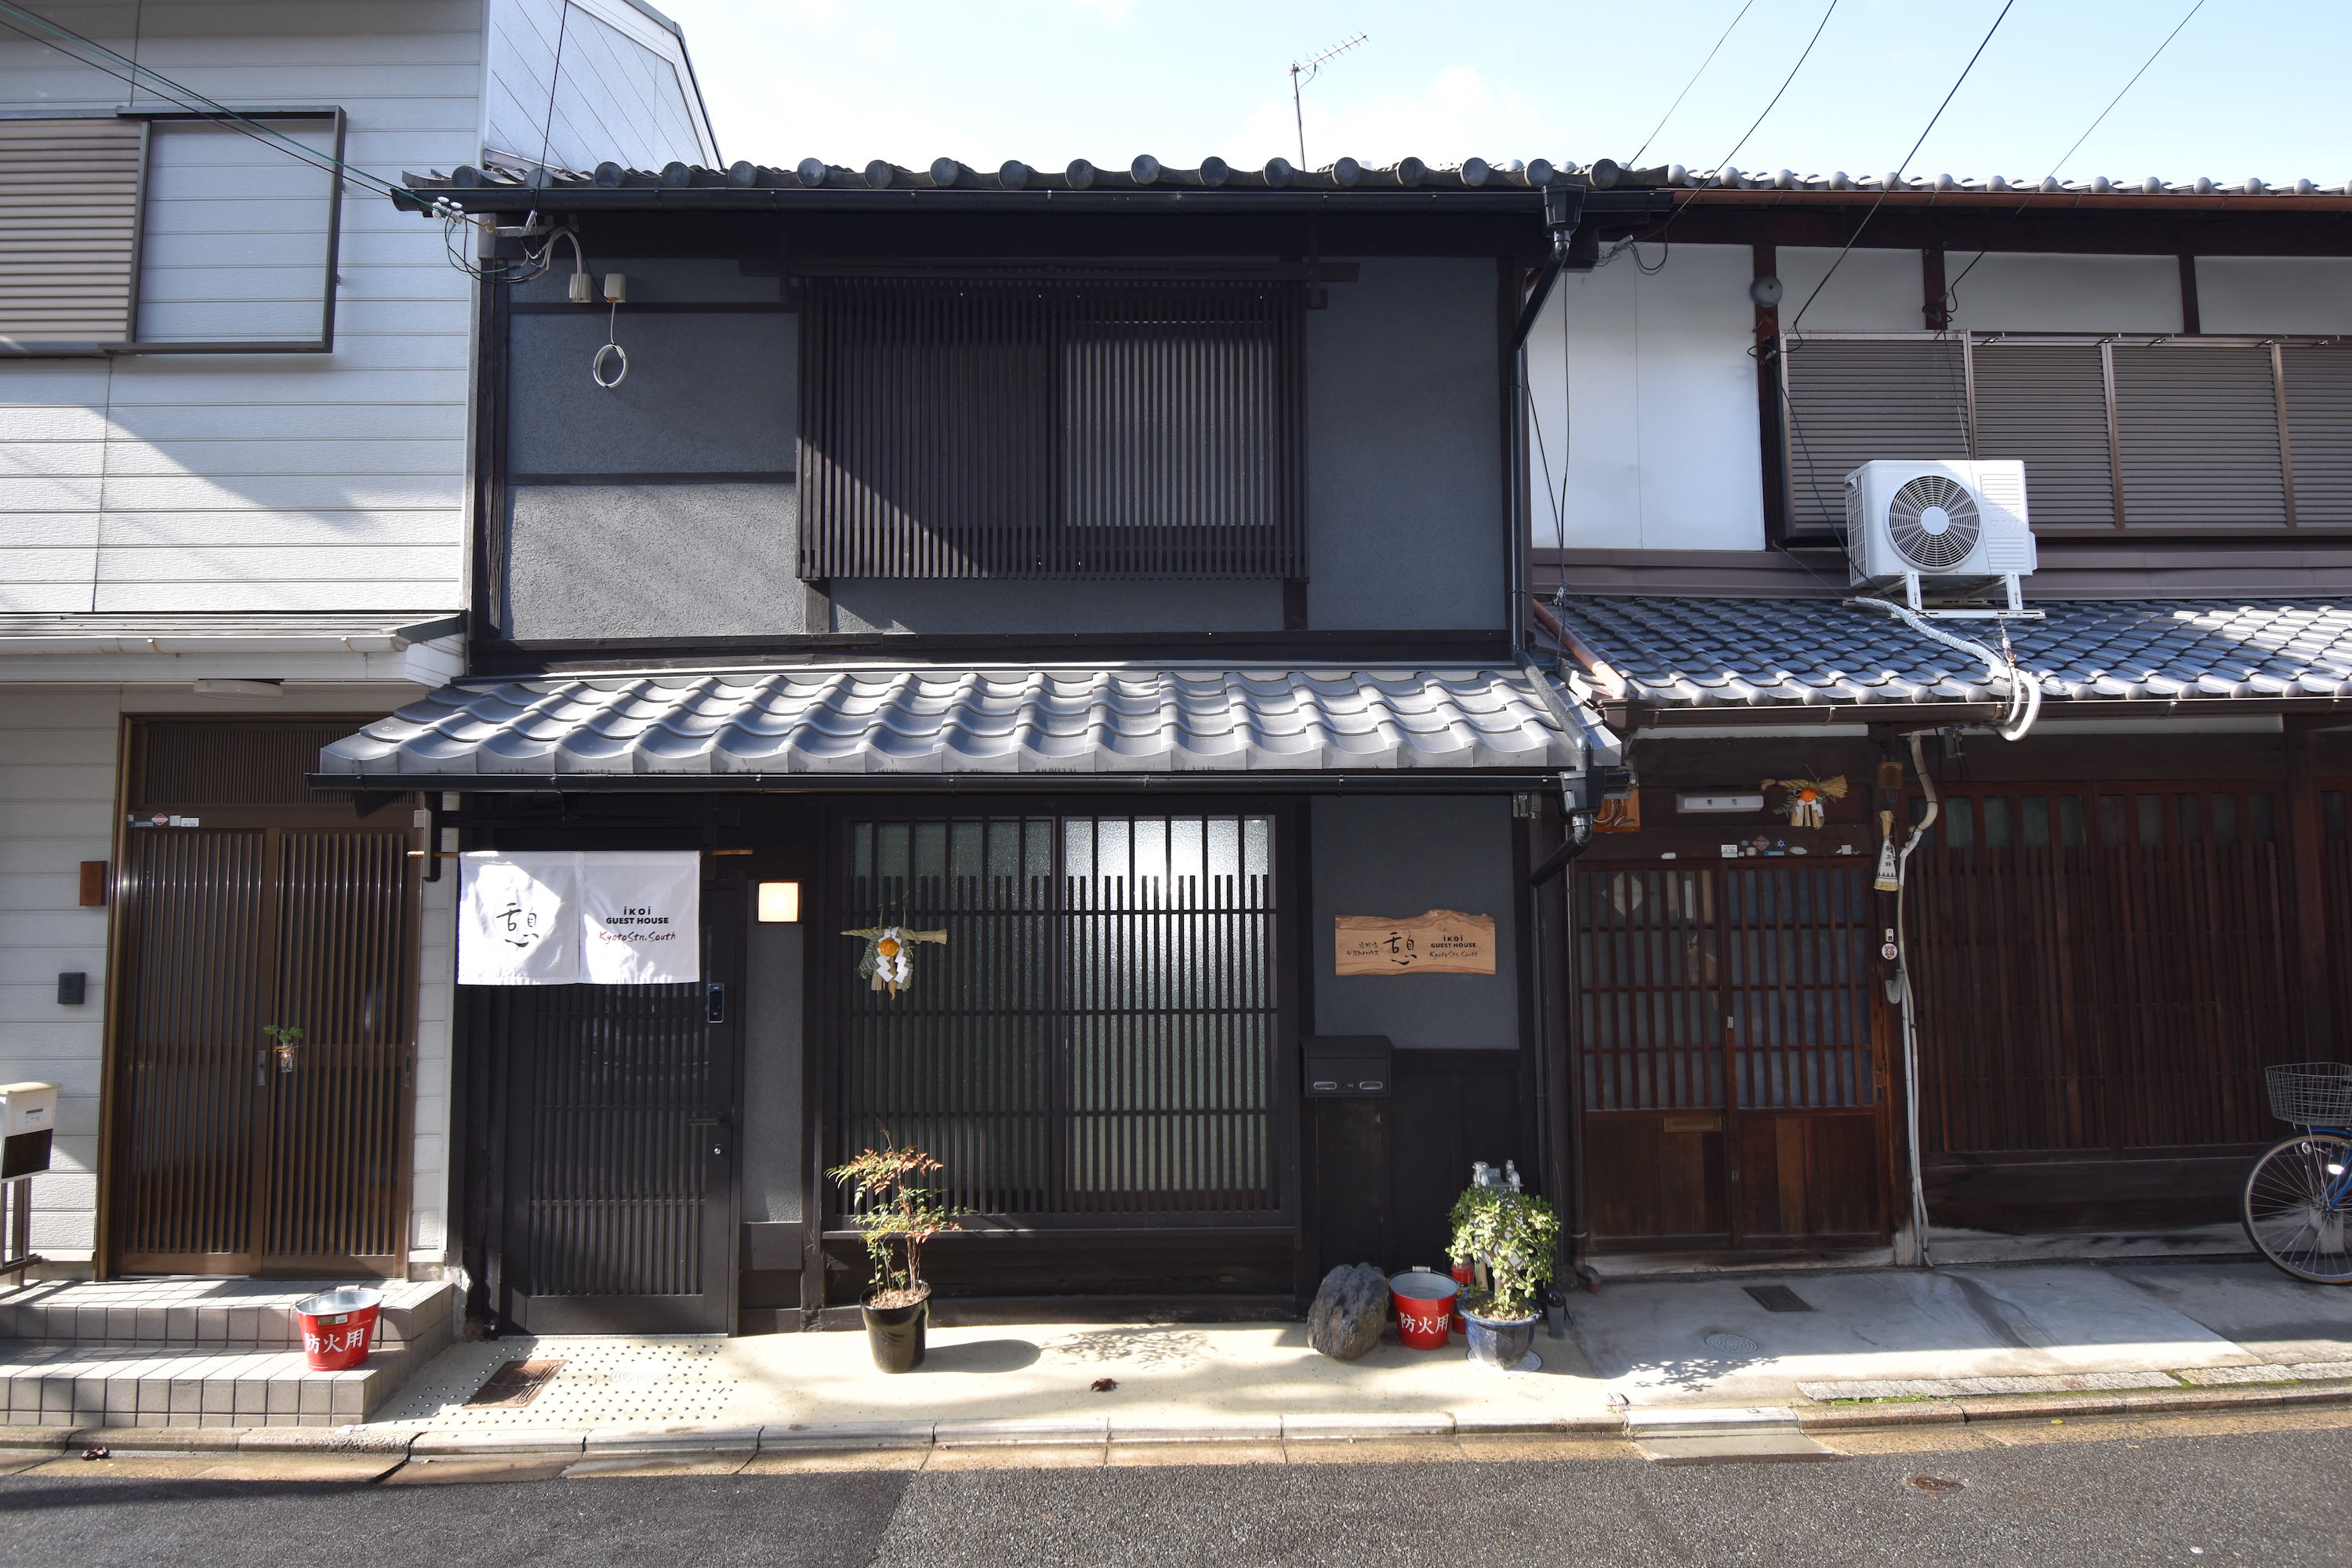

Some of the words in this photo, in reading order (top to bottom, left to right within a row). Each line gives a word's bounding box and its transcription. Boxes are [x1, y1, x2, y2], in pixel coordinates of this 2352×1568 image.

[1399, 1311, 1450, 1334] 防火用
[304, 1327, 365, 1354] 防火用
